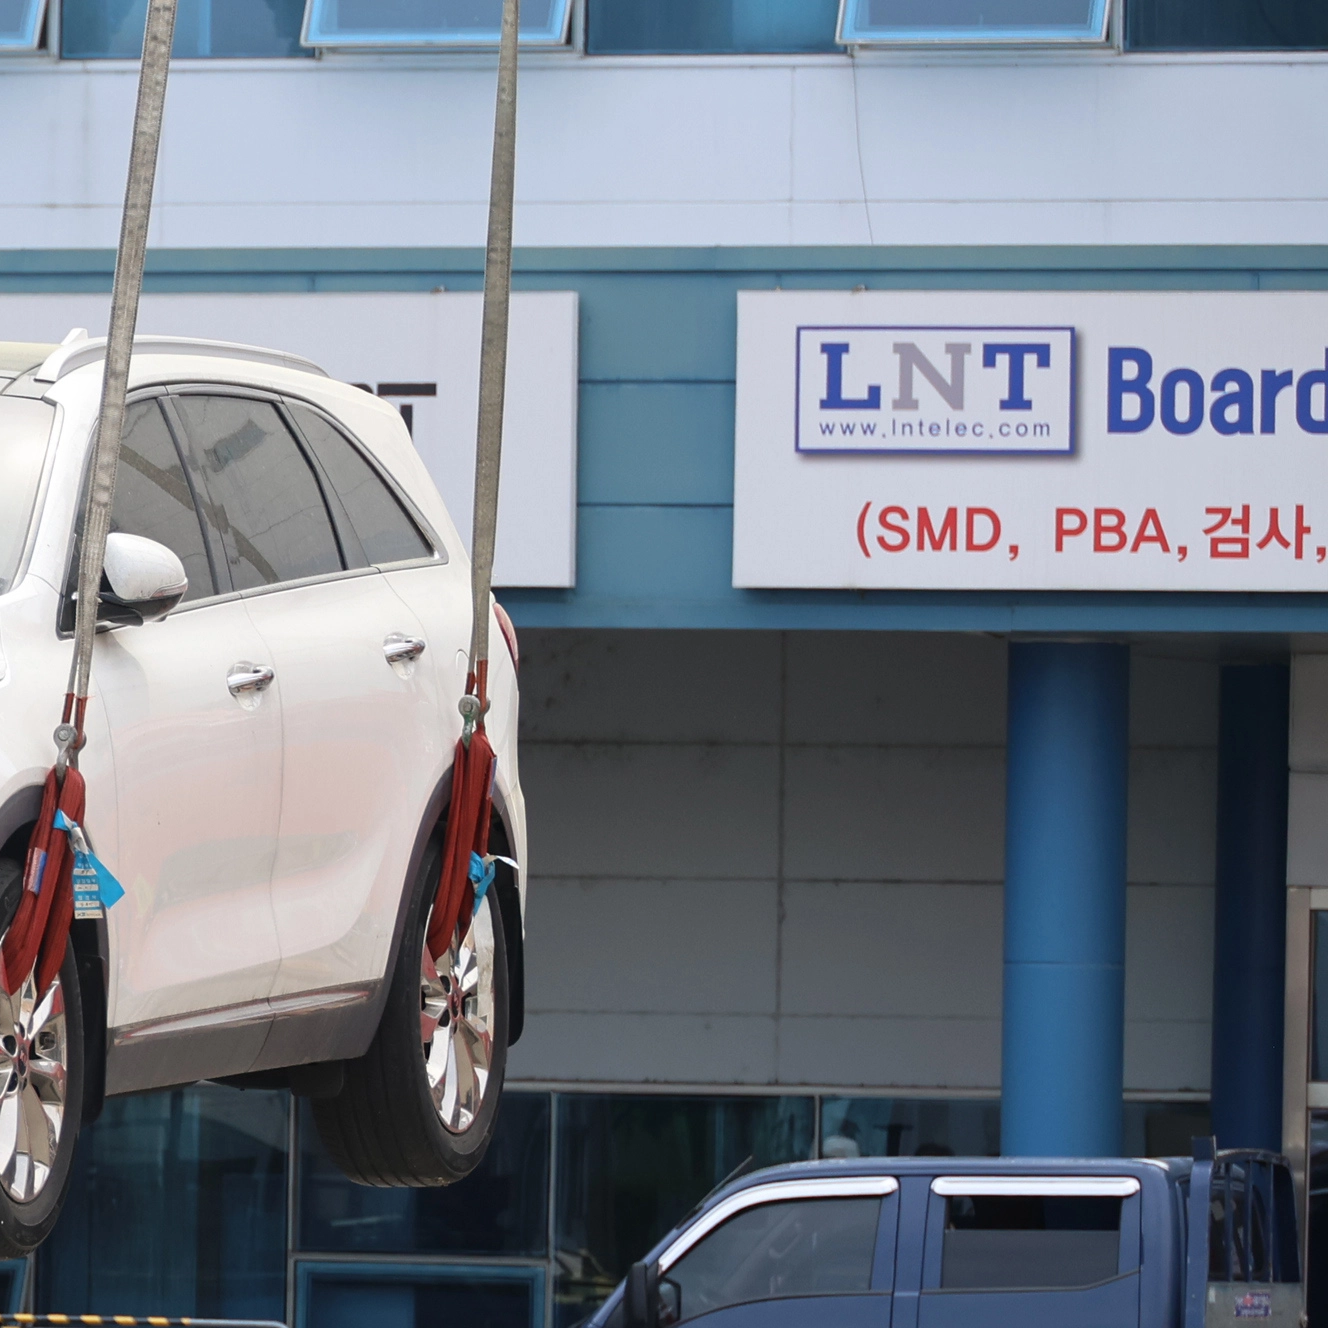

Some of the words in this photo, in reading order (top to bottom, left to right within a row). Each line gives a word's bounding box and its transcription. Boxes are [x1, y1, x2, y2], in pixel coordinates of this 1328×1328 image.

[819, 342, 1051, 411] LNT
[1107, 347, 1328, 434] Board
[819, 418, 1051, 439] www.lntelec.com
[856, 501, 1020, 561] (SMD,
